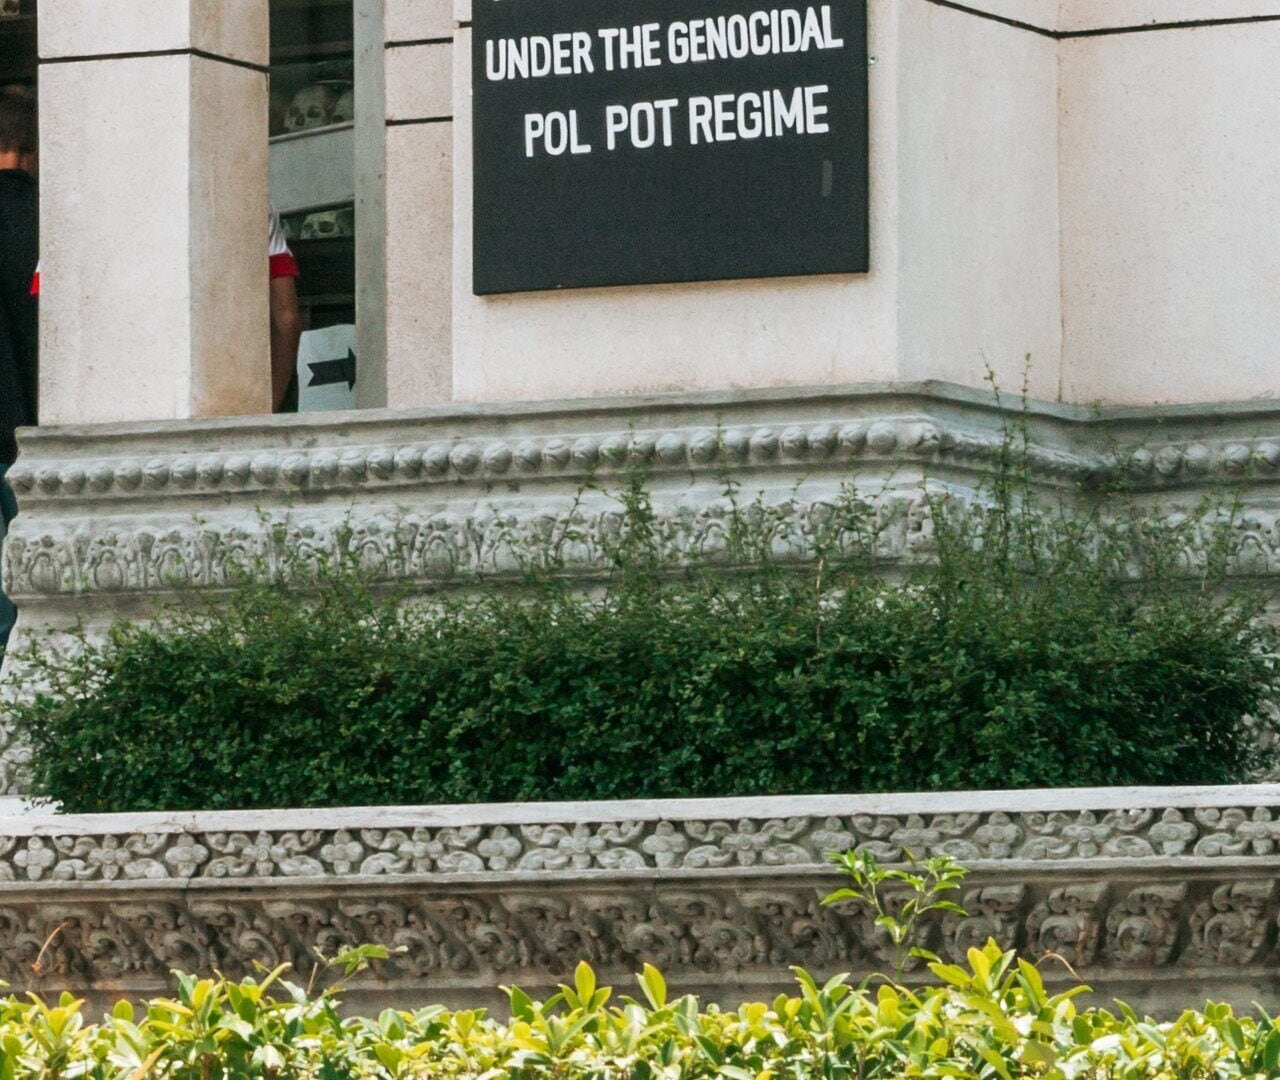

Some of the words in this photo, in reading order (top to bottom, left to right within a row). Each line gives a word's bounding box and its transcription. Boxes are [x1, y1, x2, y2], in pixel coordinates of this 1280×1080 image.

[486, 32, 594, 81] UNDER
[598, 23, 661, 71] THE
[668, 5, 844, 64] GENOCIDAL
[525, 110, 591, 157] POL
[606, 98, 678, 150] POT
[689, 85, 829, 144] REGIME
